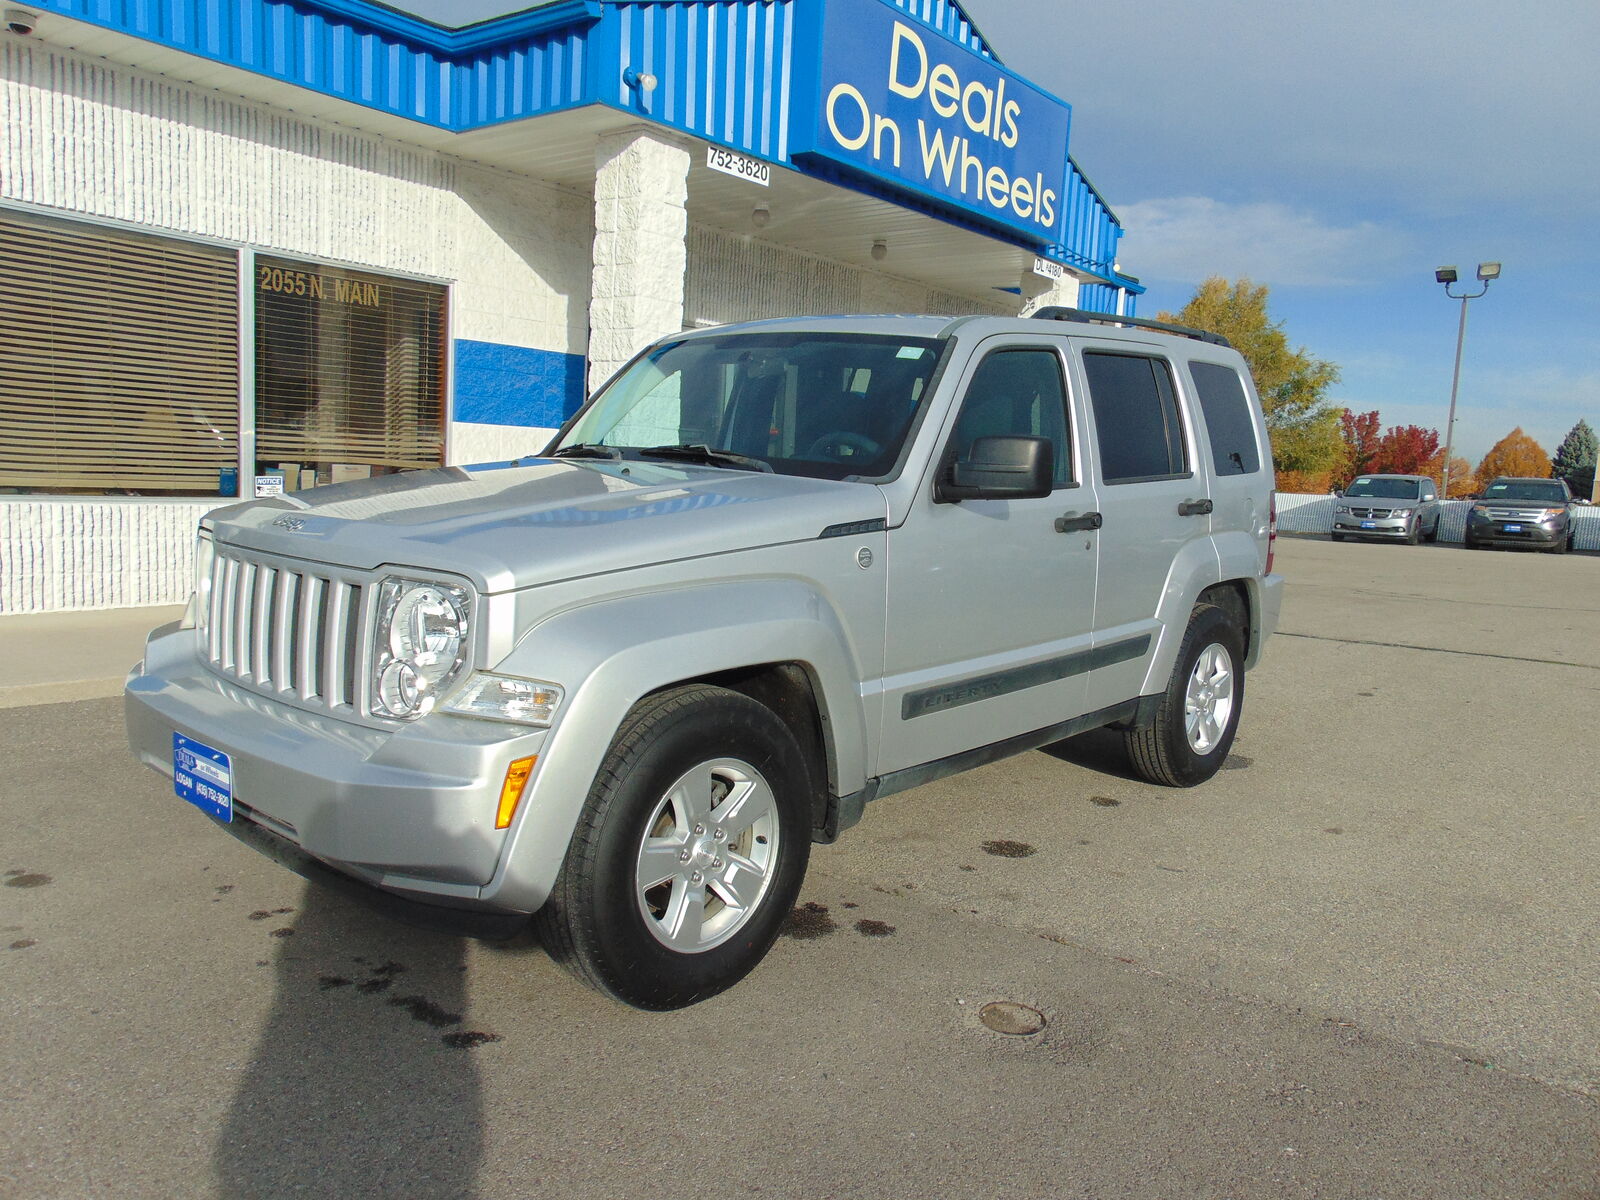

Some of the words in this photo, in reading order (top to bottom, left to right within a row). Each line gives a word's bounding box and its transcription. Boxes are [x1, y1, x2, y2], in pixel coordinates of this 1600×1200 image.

[889, 20, 1021, 148] Deals
[710, 146, 768, 181] 752-3620
[826, 83, 900, 168] On
[918, 119, 1056, 228] Wheels
[1036, 259, 1044, 272] DL
[261, 266, 306, 296] 2055
[335, 279, 379, 307] MAIN
[176, 771, 193, 789] LOGAN
